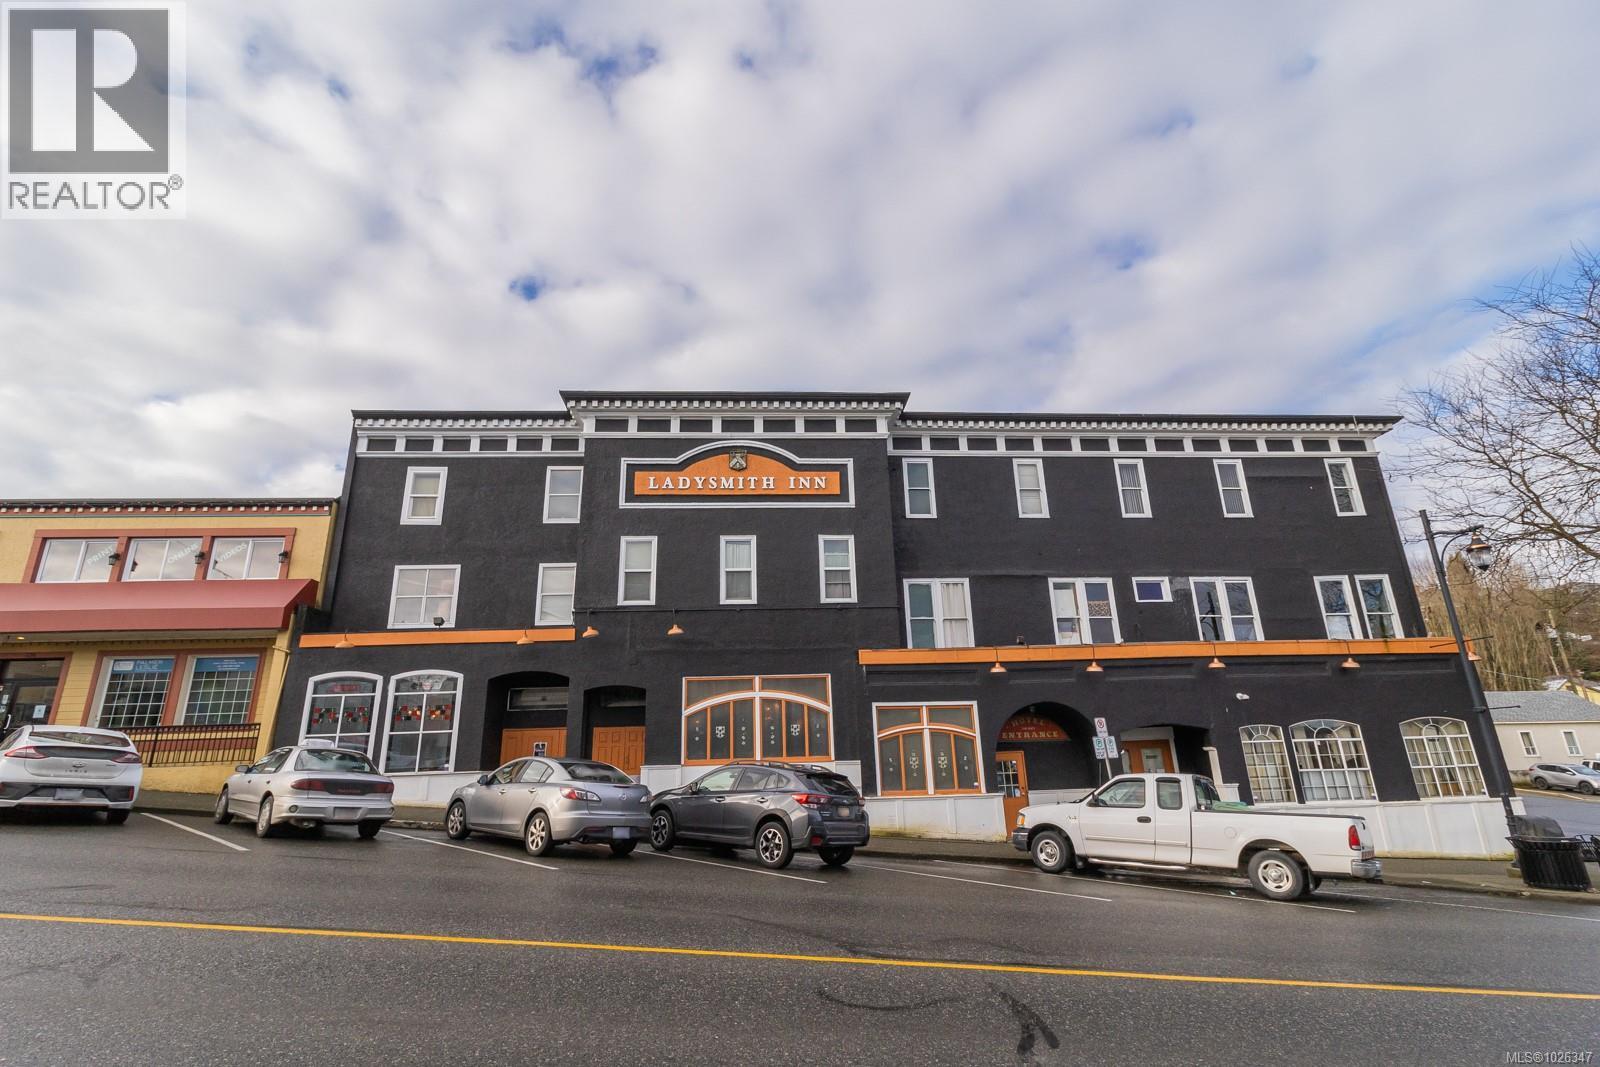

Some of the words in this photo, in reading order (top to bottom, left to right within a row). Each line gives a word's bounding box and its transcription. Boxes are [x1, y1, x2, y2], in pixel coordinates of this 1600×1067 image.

[648, 476, 775, 489] LADYSMITH
[788, 476, 827, 489] INN
[86, 544, 114, 566] PRINT
[218, 542, 248, 562] VIDEOS
[1001, 730, 1059, 739] ENTRANCE
